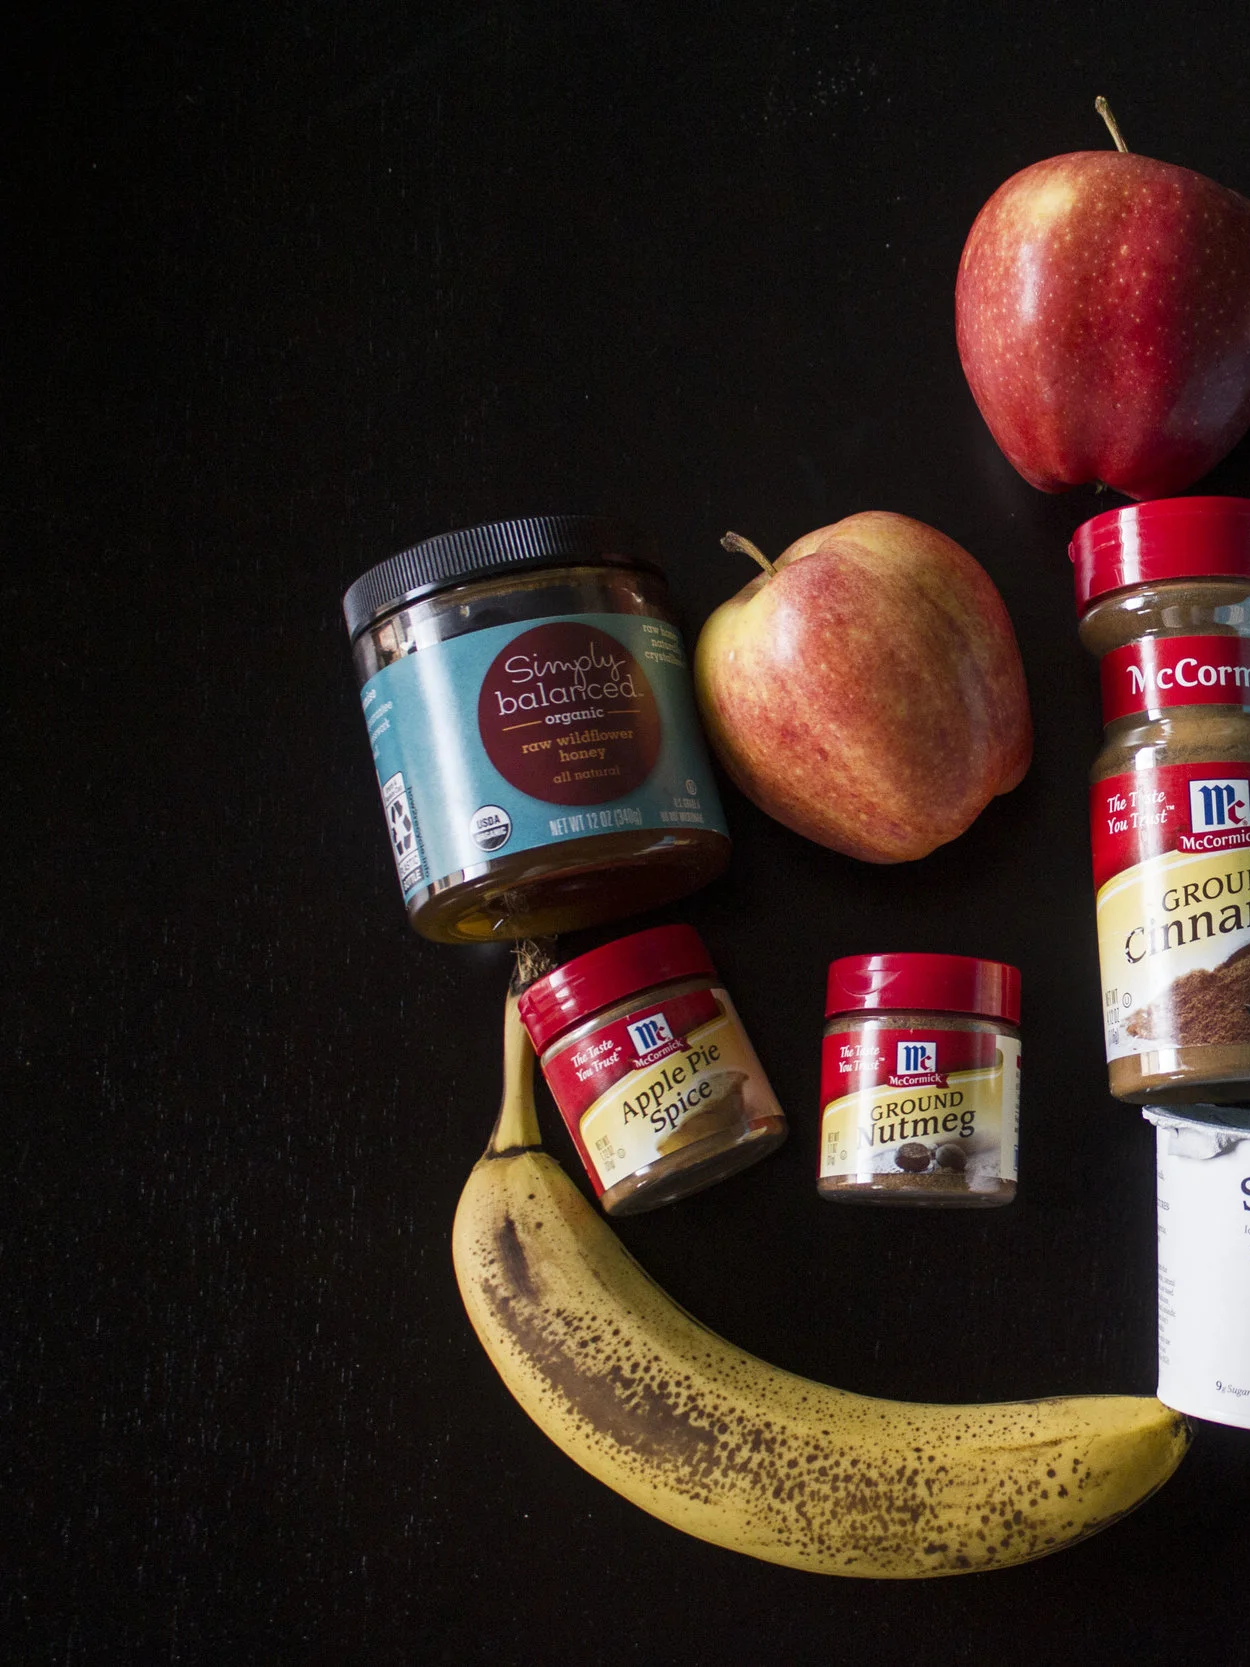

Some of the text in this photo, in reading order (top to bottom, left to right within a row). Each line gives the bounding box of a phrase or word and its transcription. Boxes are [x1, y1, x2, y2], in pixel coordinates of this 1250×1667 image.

[505, 641, 626, 690] Simply
[495, 674, 639, 716] balanced
[545, 706, 604, 725] organic
[522, 729, 633, 754] raw wildflower
[560, 747, 605, 763] honey
[552, 765, 621, 784] all natural
[1107, 789, 1167, 813] The Taste
[476, 814, 501, 829] USDA
[549, 818, 568, 836] NET
[568, 815, 585, 833] WT
[586, 812, 599, 829] 12
[600, 809, 613, 827] OZ
[1107, 818, 1128, 835] You
[570, 1039, 614, 1068] The Taste
[632, 1039, 685, 1068] McCormick
[840, 1044, 880, 1058] The Taste
[576, 1068, 593, 1082] You
[839, 1060, 852, 1073] You
[621, 1043, 721, 1125] Apple Pie
[888, 1073, 942, 1086] McCormick
[650, 1079, 713, 1133] Spice
[870, 1091, 964, 1122] GROUND
[857, 1110, 976, 1149] Nutmeg
